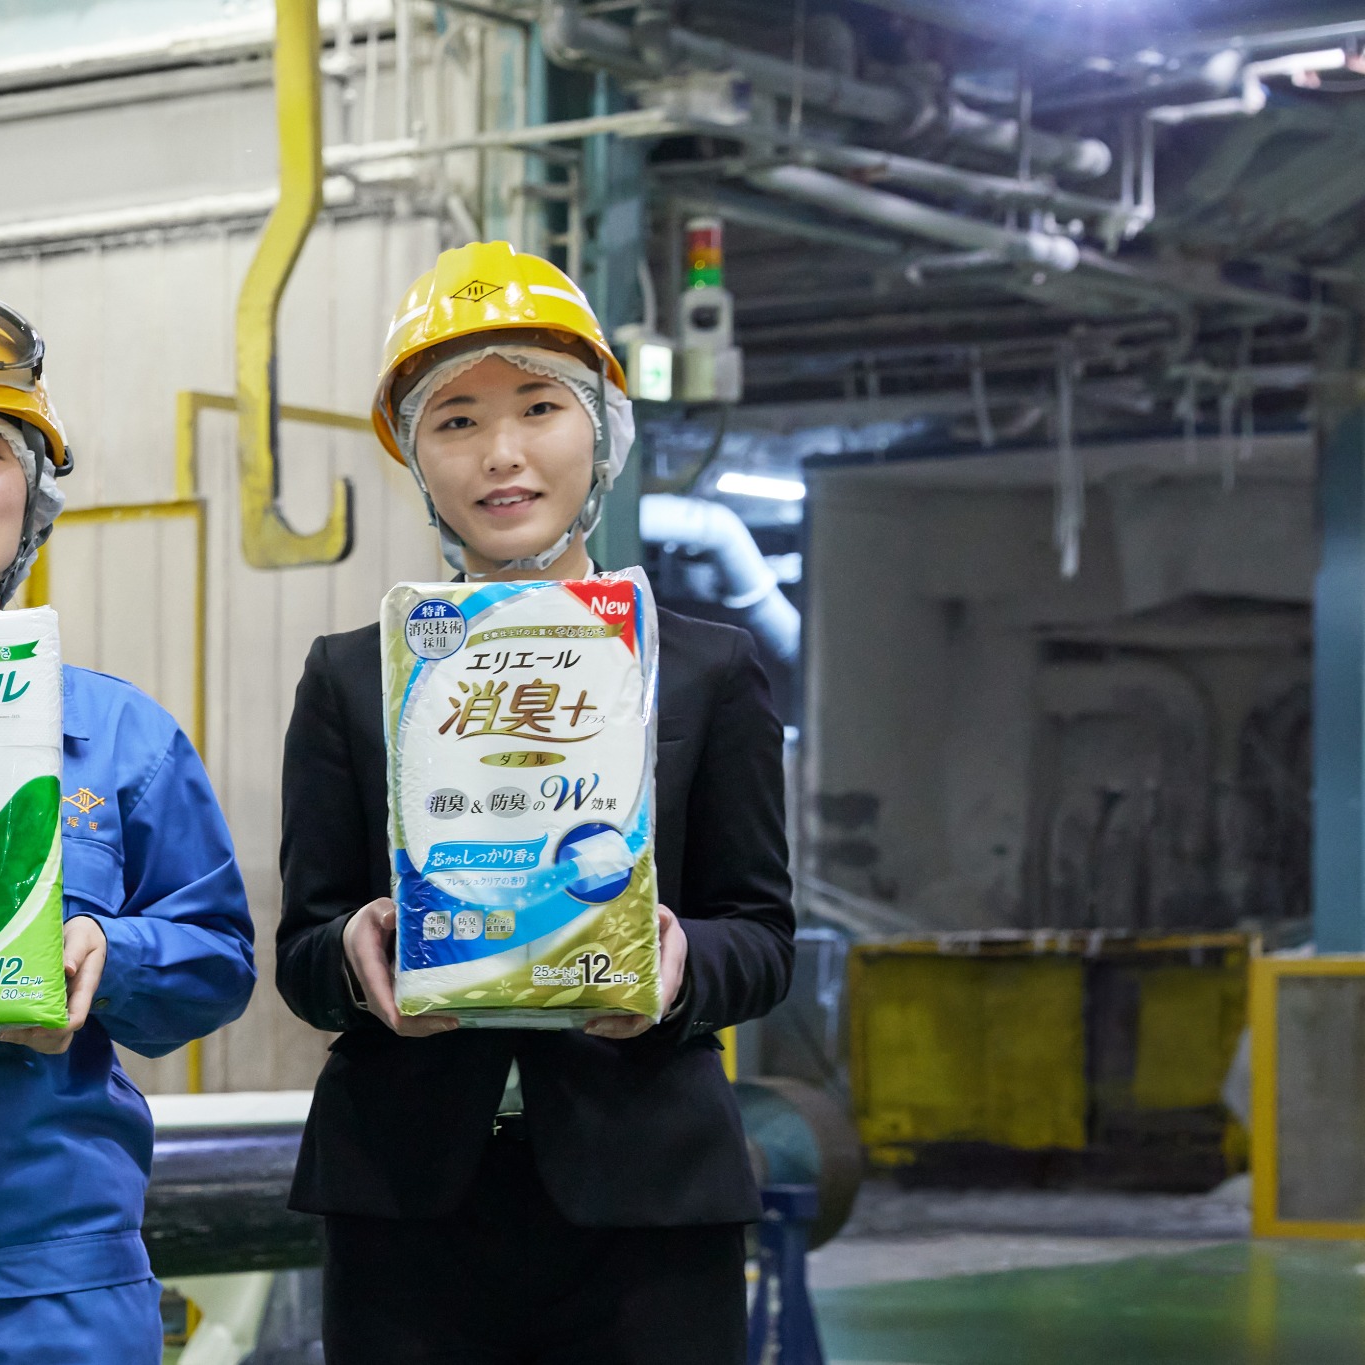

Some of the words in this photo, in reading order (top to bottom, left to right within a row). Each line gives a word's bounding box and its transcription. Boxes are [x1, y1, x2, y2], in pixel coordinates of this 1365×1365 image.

[422, 605, 447, 617] 特許
[590, 596, 630, 615] New
[409, 621, 462, 636] 消臭技術
[465, 649, 581, 674] エリエール
[581, 715, 606, 724] プラス
[500, 753, 547, 765] ダブル
[431, 849, 536, 867] 芯からしっかり香る
[445, 876, 526, 886] フレッシュクリアの香り
[533, 966, 578, 977] 25メートル
[578, 954, 637, 983] 12ロール
[1, 989, 43, 999] 30メートル
